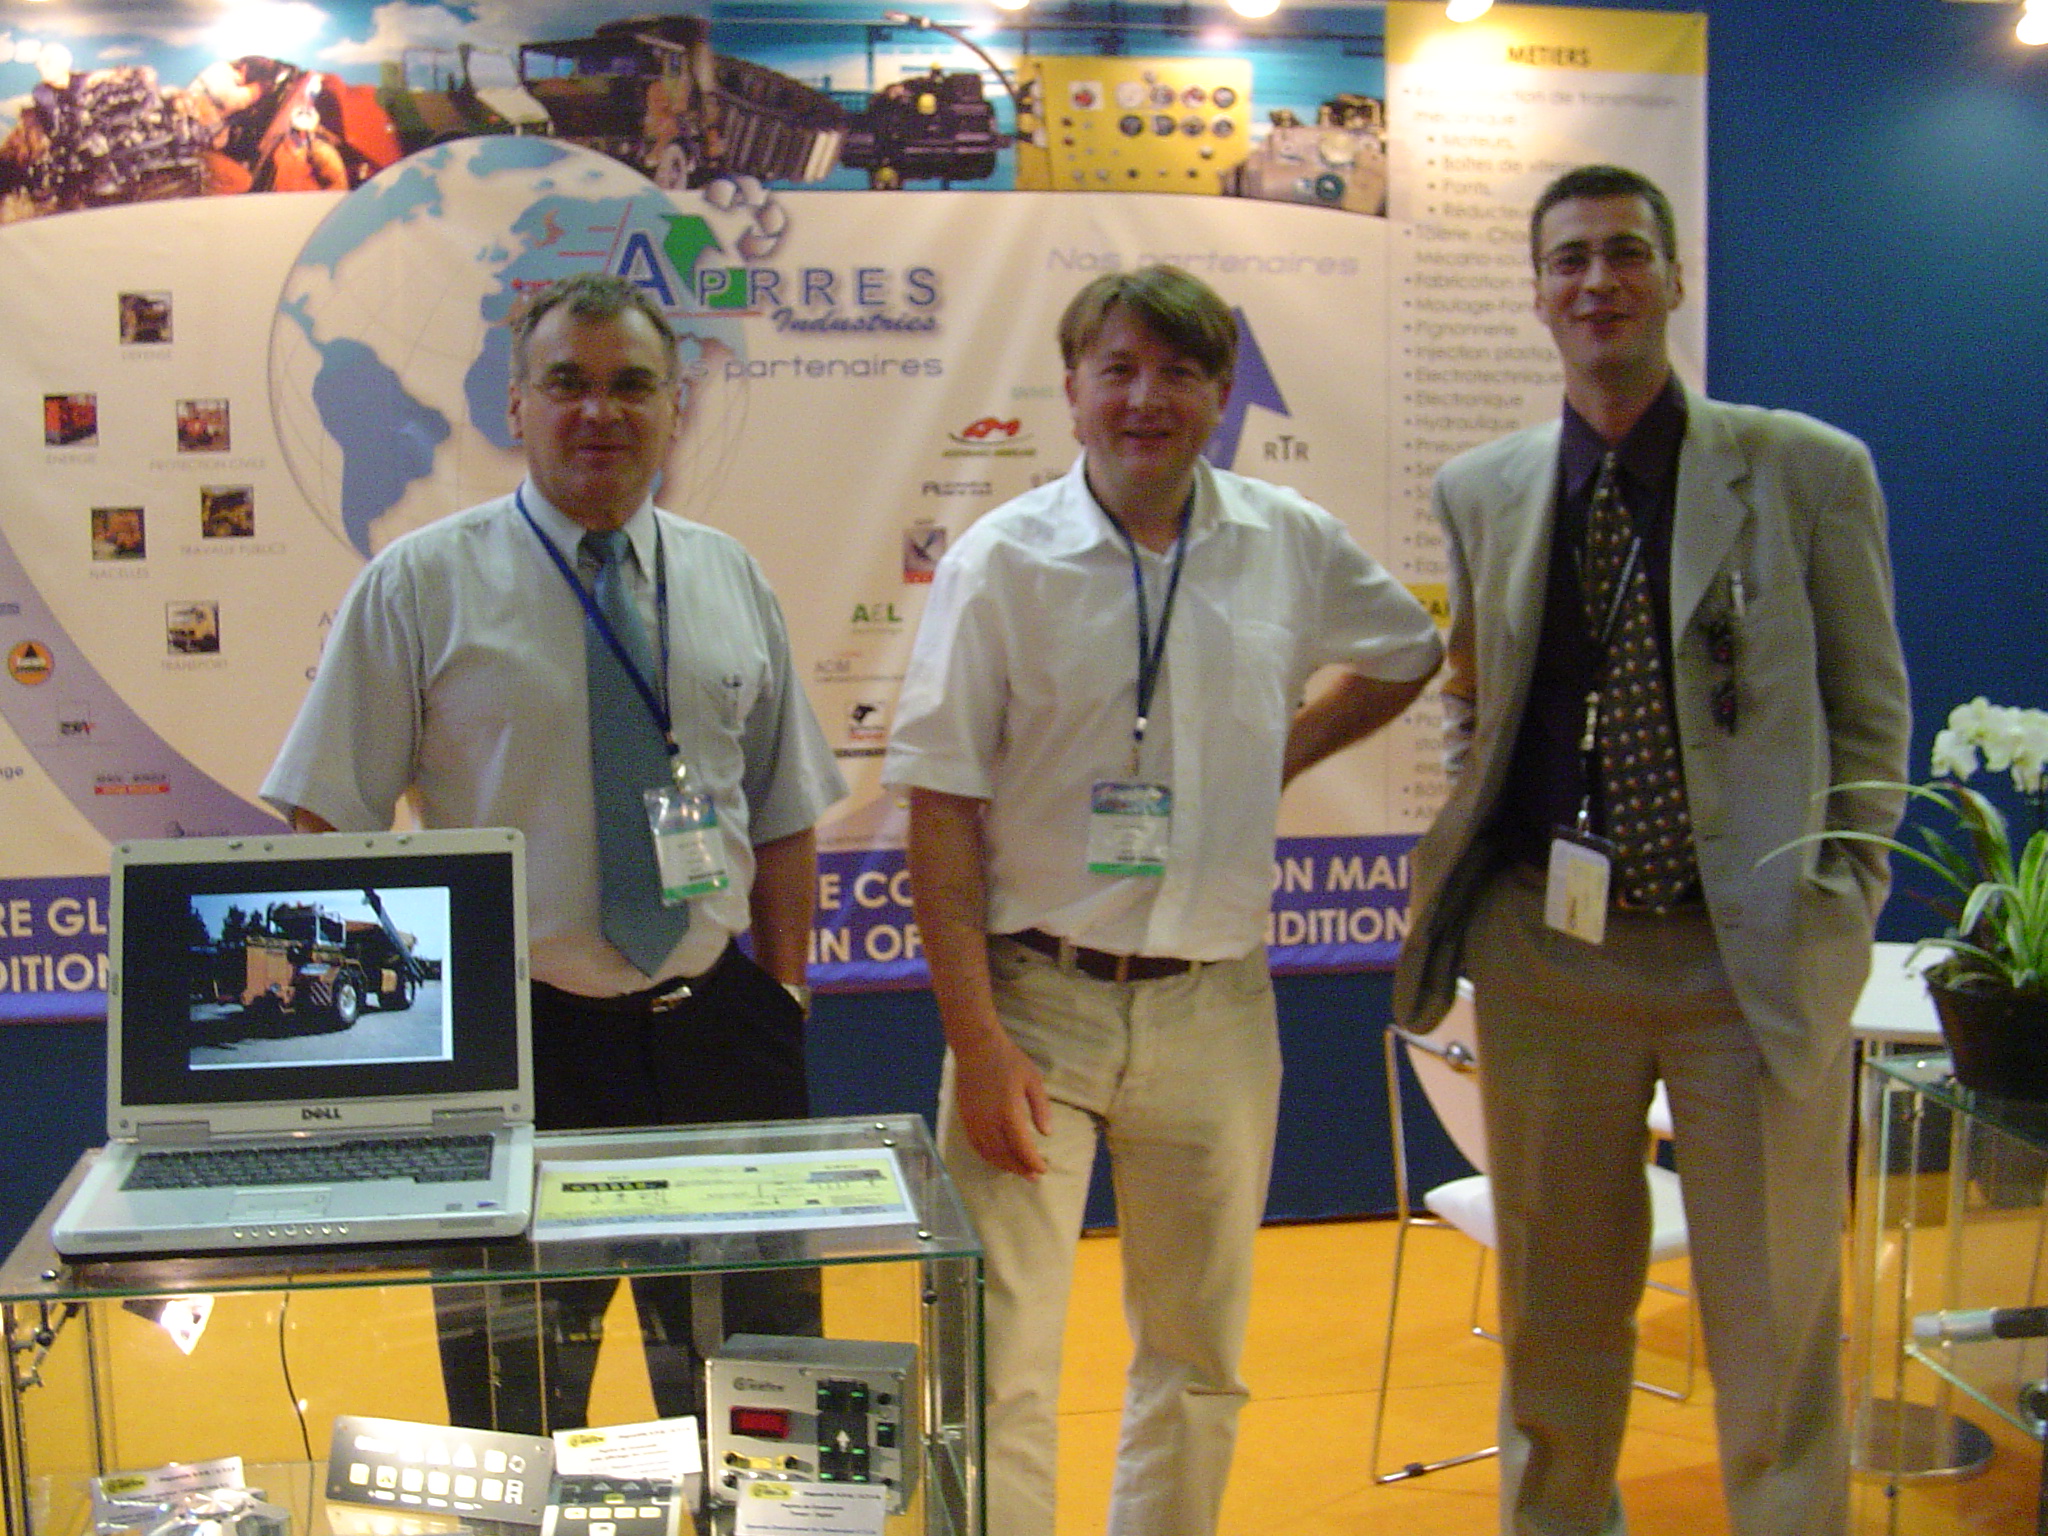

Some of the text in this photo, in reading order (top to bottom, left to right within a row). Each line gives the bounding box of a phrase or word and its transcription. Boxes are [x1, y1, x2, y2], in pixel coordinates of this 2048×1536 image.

[613, 232, 935, 308] APRRES
[1046, 248, 1359, 277] Nos partenaires
[771, 308, 935, 333] Industries
[724, 353, 944, 382] partenaires
[1262, 434, 1310, 461] RTR
[1325, 854, 1409, 892] MAI
[302, 1106, 343, 1121] DELL
